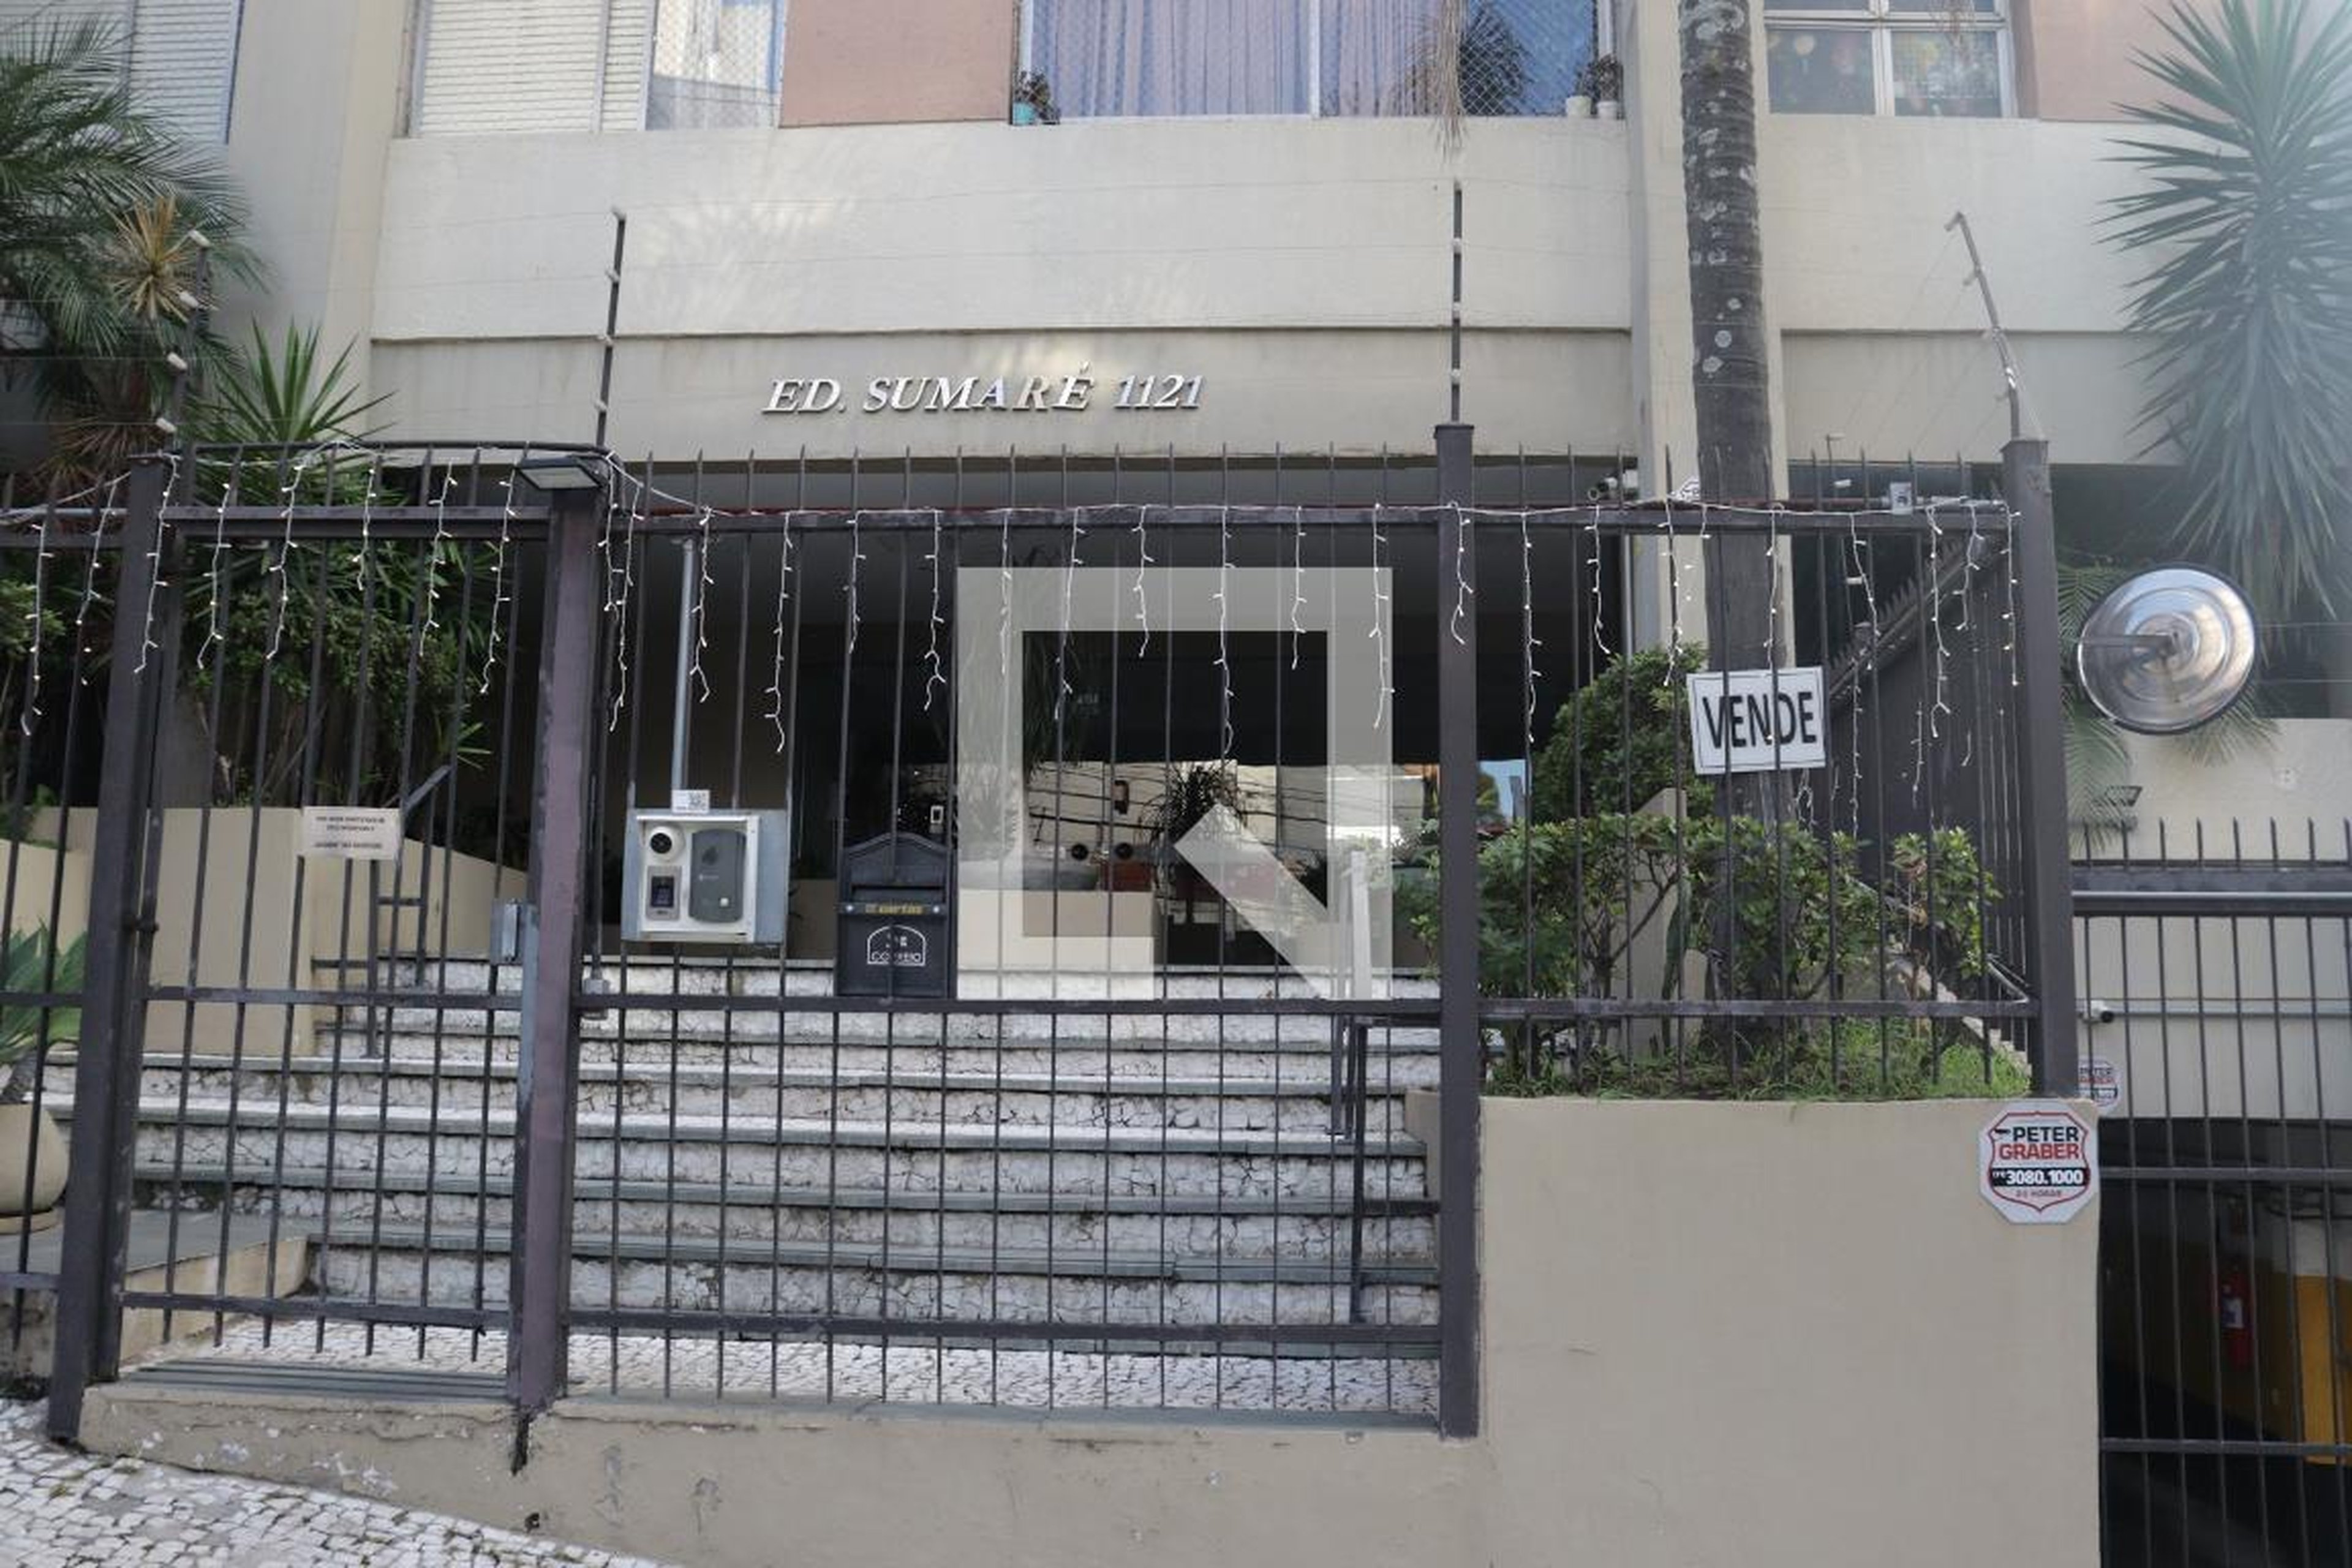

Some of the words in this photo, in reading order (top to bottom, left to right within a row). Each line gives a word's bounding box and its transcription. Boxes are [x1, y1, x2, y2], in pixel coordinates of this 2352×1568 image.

[761, 377, 846, 413] ED.
[862, 360, 1095, 413] SUMARÉ
[1114, 374, 1204, 410] 1121
[1702, 691, 1817, 748] VENDE
[2013, 1126, 2079, 1142] PETER
[1999, 1143, 2079, 1159] GRABER
[2006, 1169, 2083, 1185] 3080.1000
